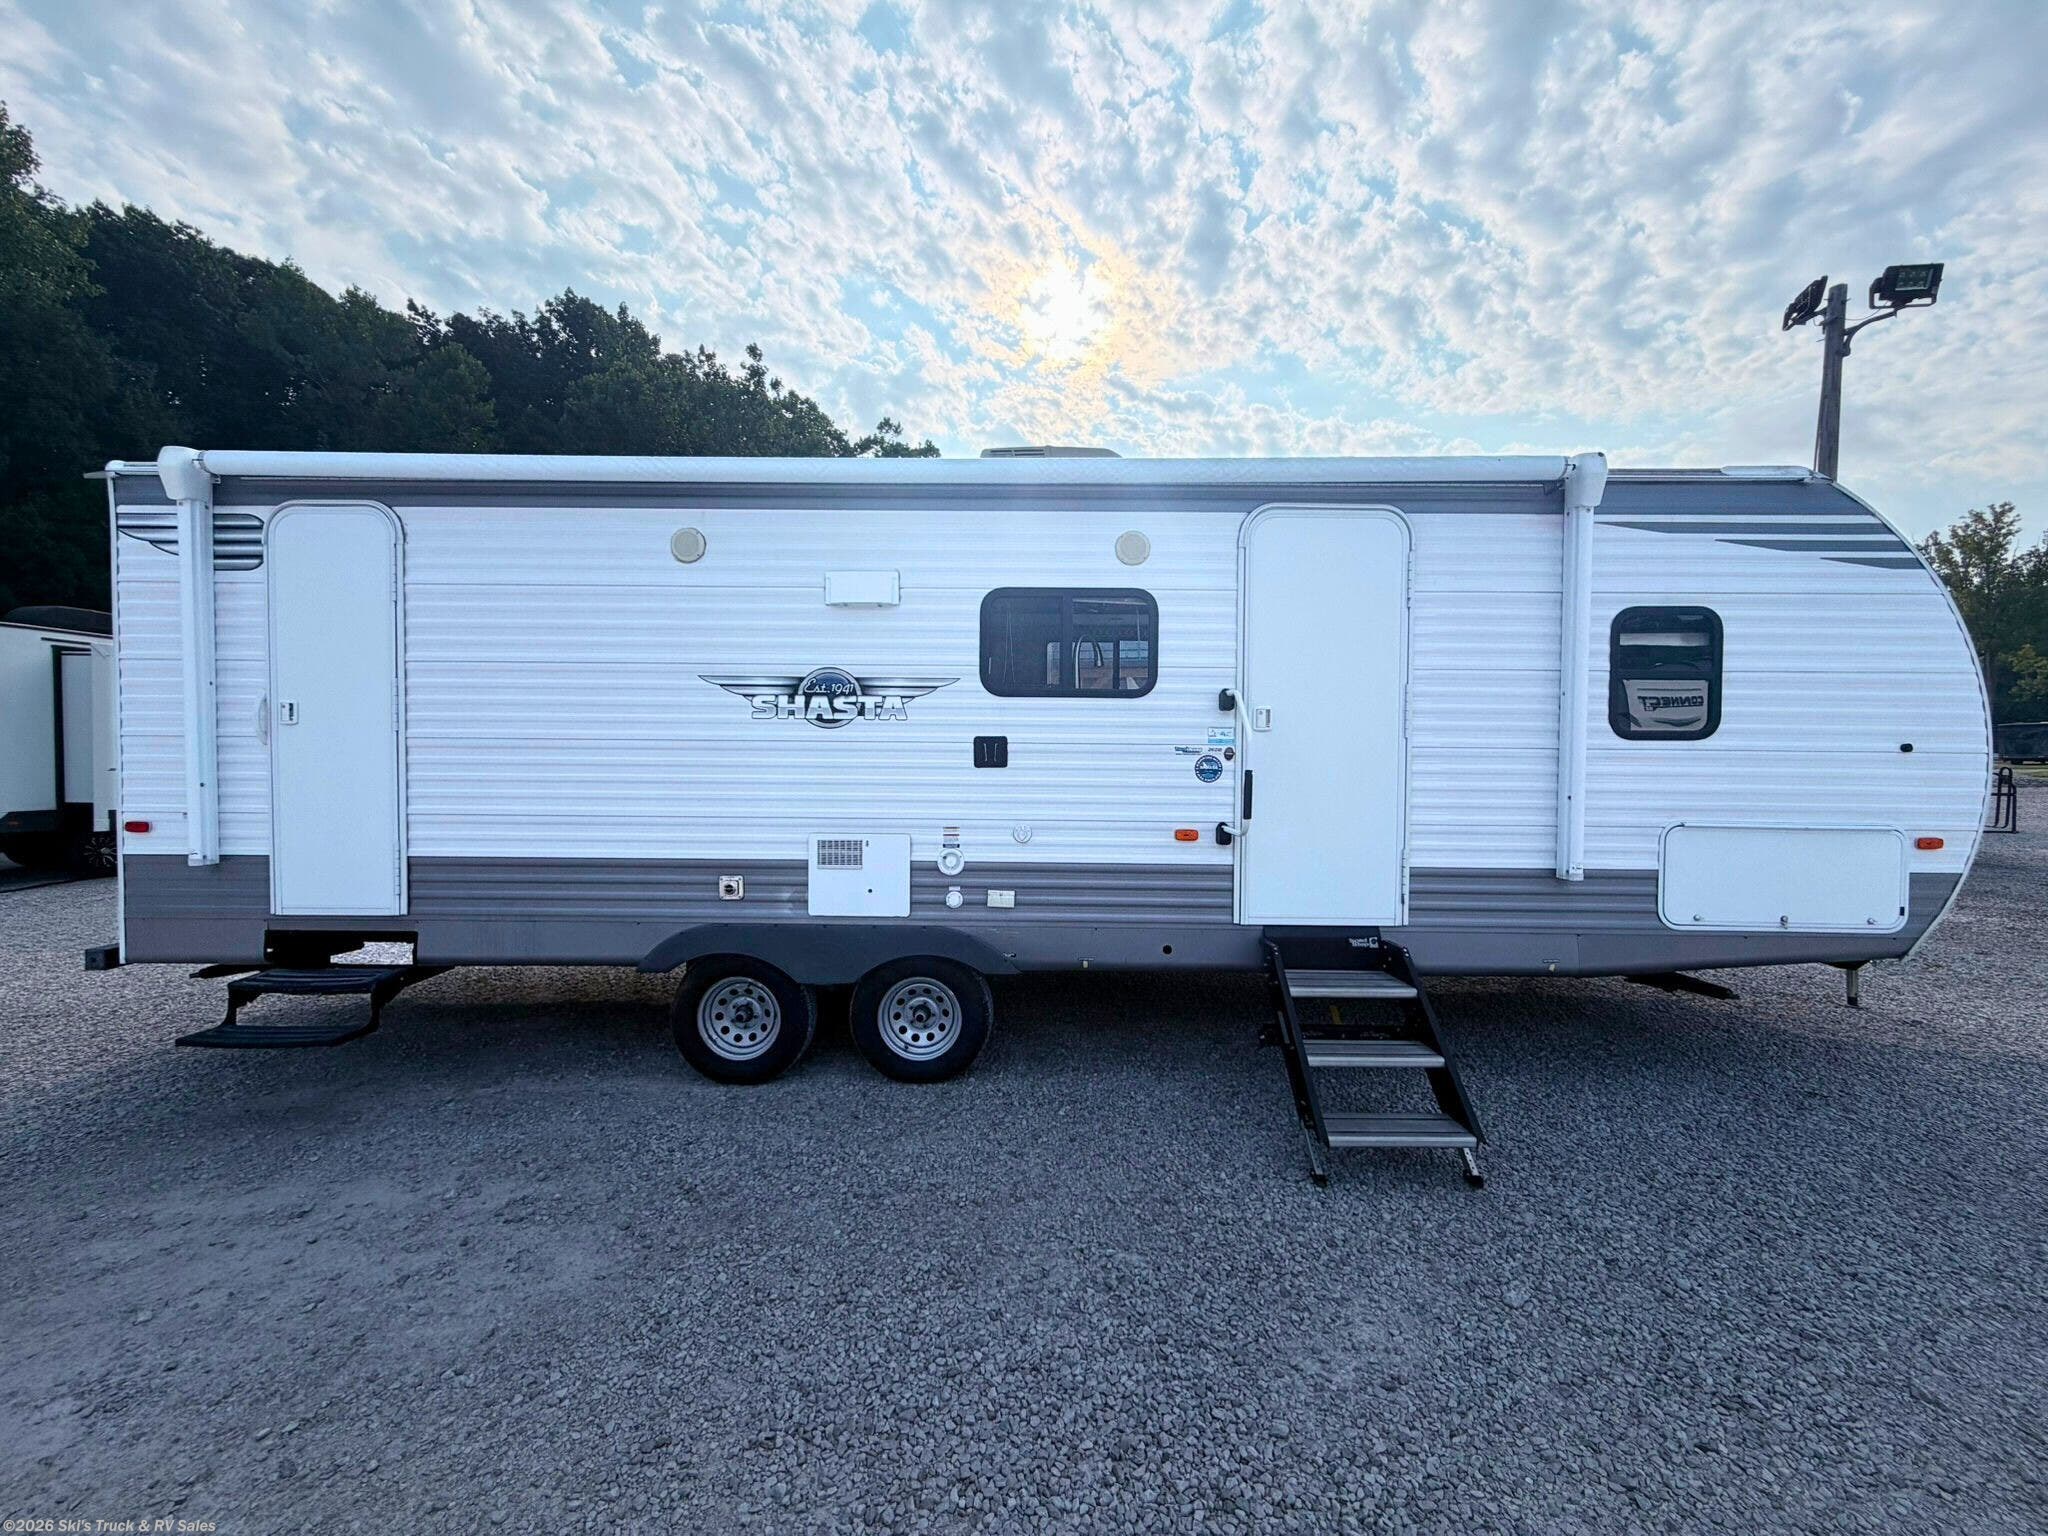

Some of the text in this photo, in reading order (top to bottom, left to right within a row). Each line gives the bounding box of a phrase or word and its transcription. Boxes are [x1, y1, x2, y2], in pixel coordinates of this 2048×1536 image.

[804, 677, 855, 695] Est. 1941
[751, 694, 909, 721] SHASTA
